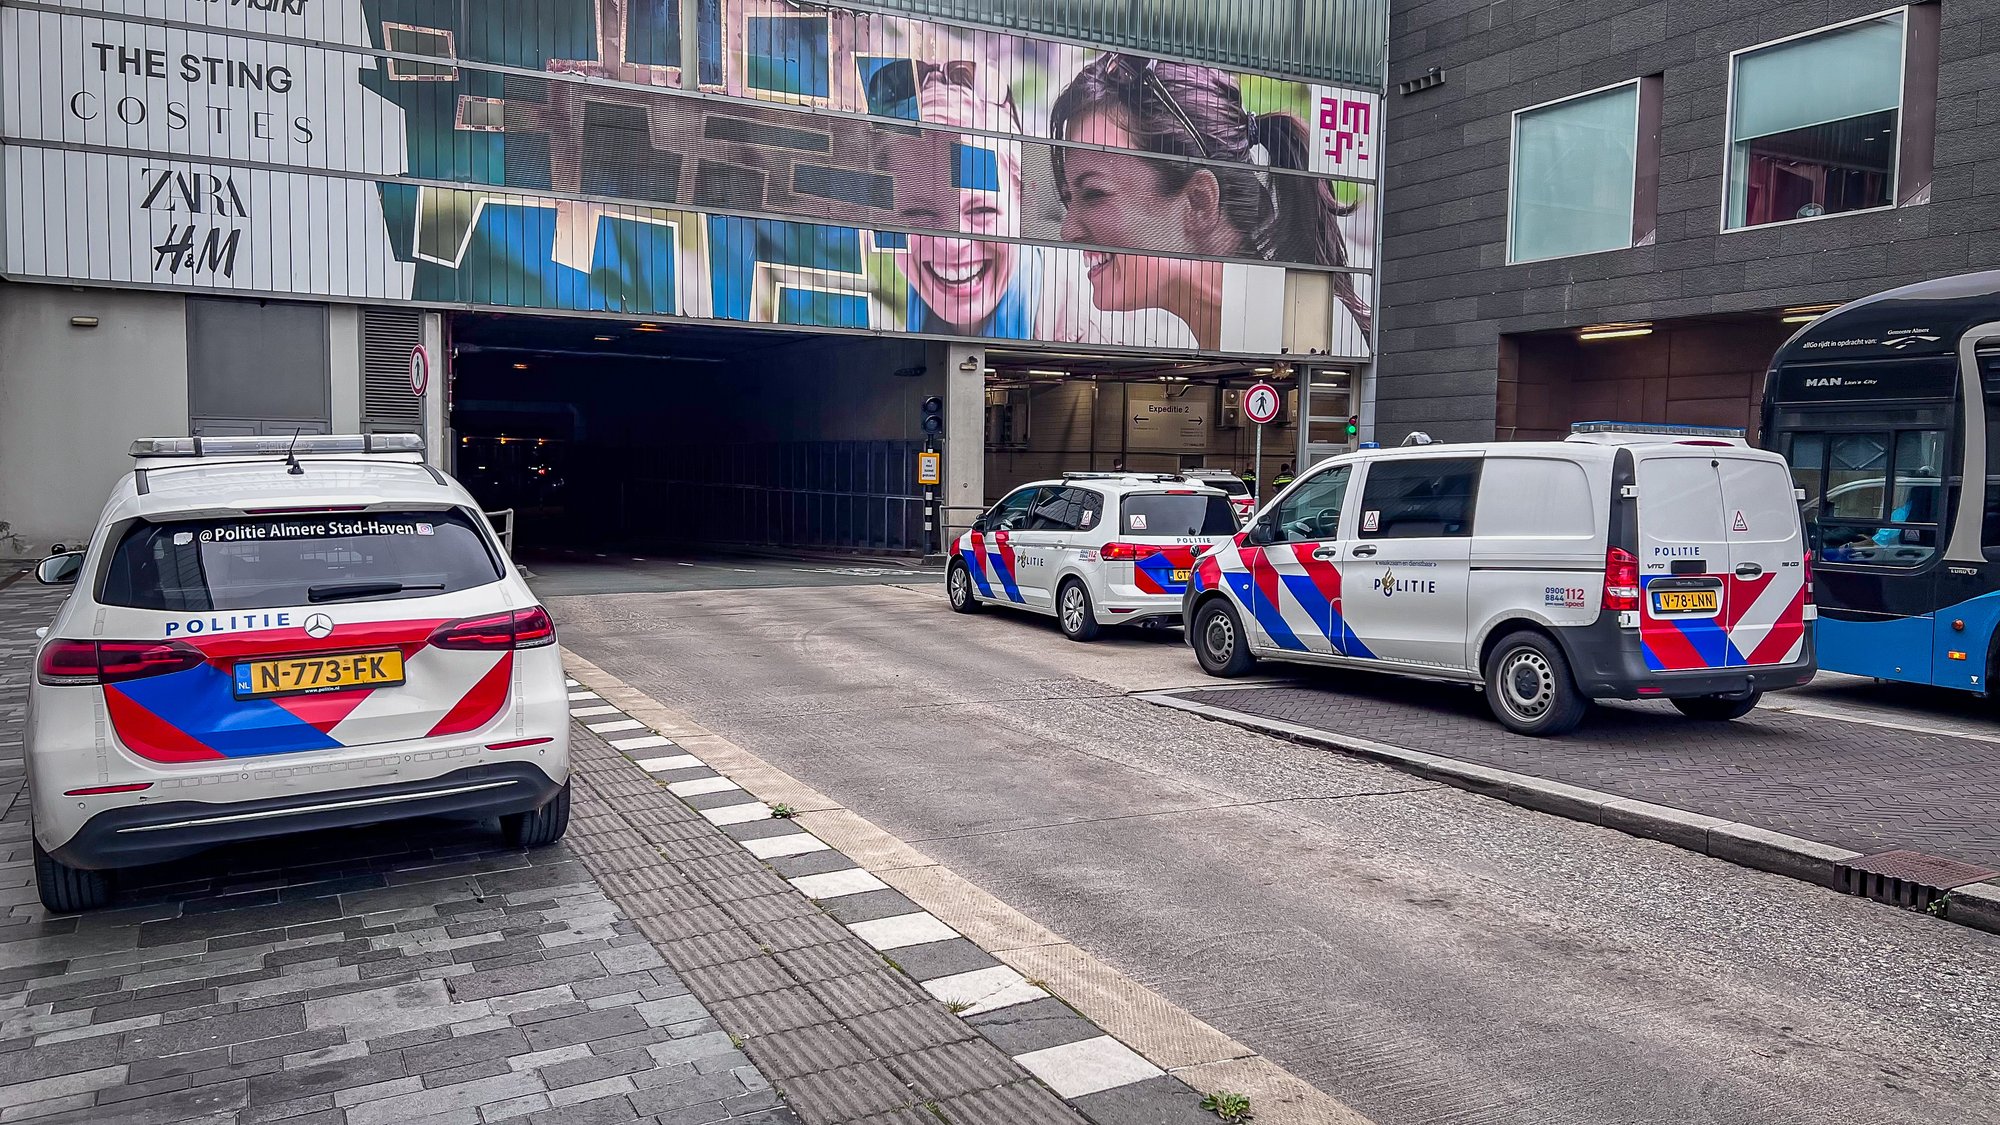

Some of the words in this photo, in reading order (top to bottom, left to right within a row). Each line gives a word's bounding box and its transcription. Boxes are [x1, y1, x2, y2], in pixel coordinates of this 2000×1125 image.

[92, 42, 166, 79] THE
[180, 54, 292, 93] STING
[70, 91, 313, 144] COSTES
[140, 168, 251, 218] ZARA
[154, 224, 241, 278] H&M
[1837, 339, 1864, 347] opdracht
[1806, 377, 1842, 387] MAN
[1148, 404, 1183, 414] Expeditie
[270, 522, 325, 538] Almere
[328, 521, 414, 535] Stad-Haven
[1088, 549, 1097, 558] 112
[1654, 546, 1700, 557] POLITIE
[1374, 578, 1436, 597] POLITIE
[1565, 588, 1584, 600] 112
[1545, 594, 1565, 602] 8844
[1663, 594, 1713, 607] V-78-LNN
[165, 613, 290, 637] POLITIE
[238, 682, 250, 690] NL
[261, 656, 387, 689] N-773-FK
[304, 685, 340, 694] www.politie.nl
